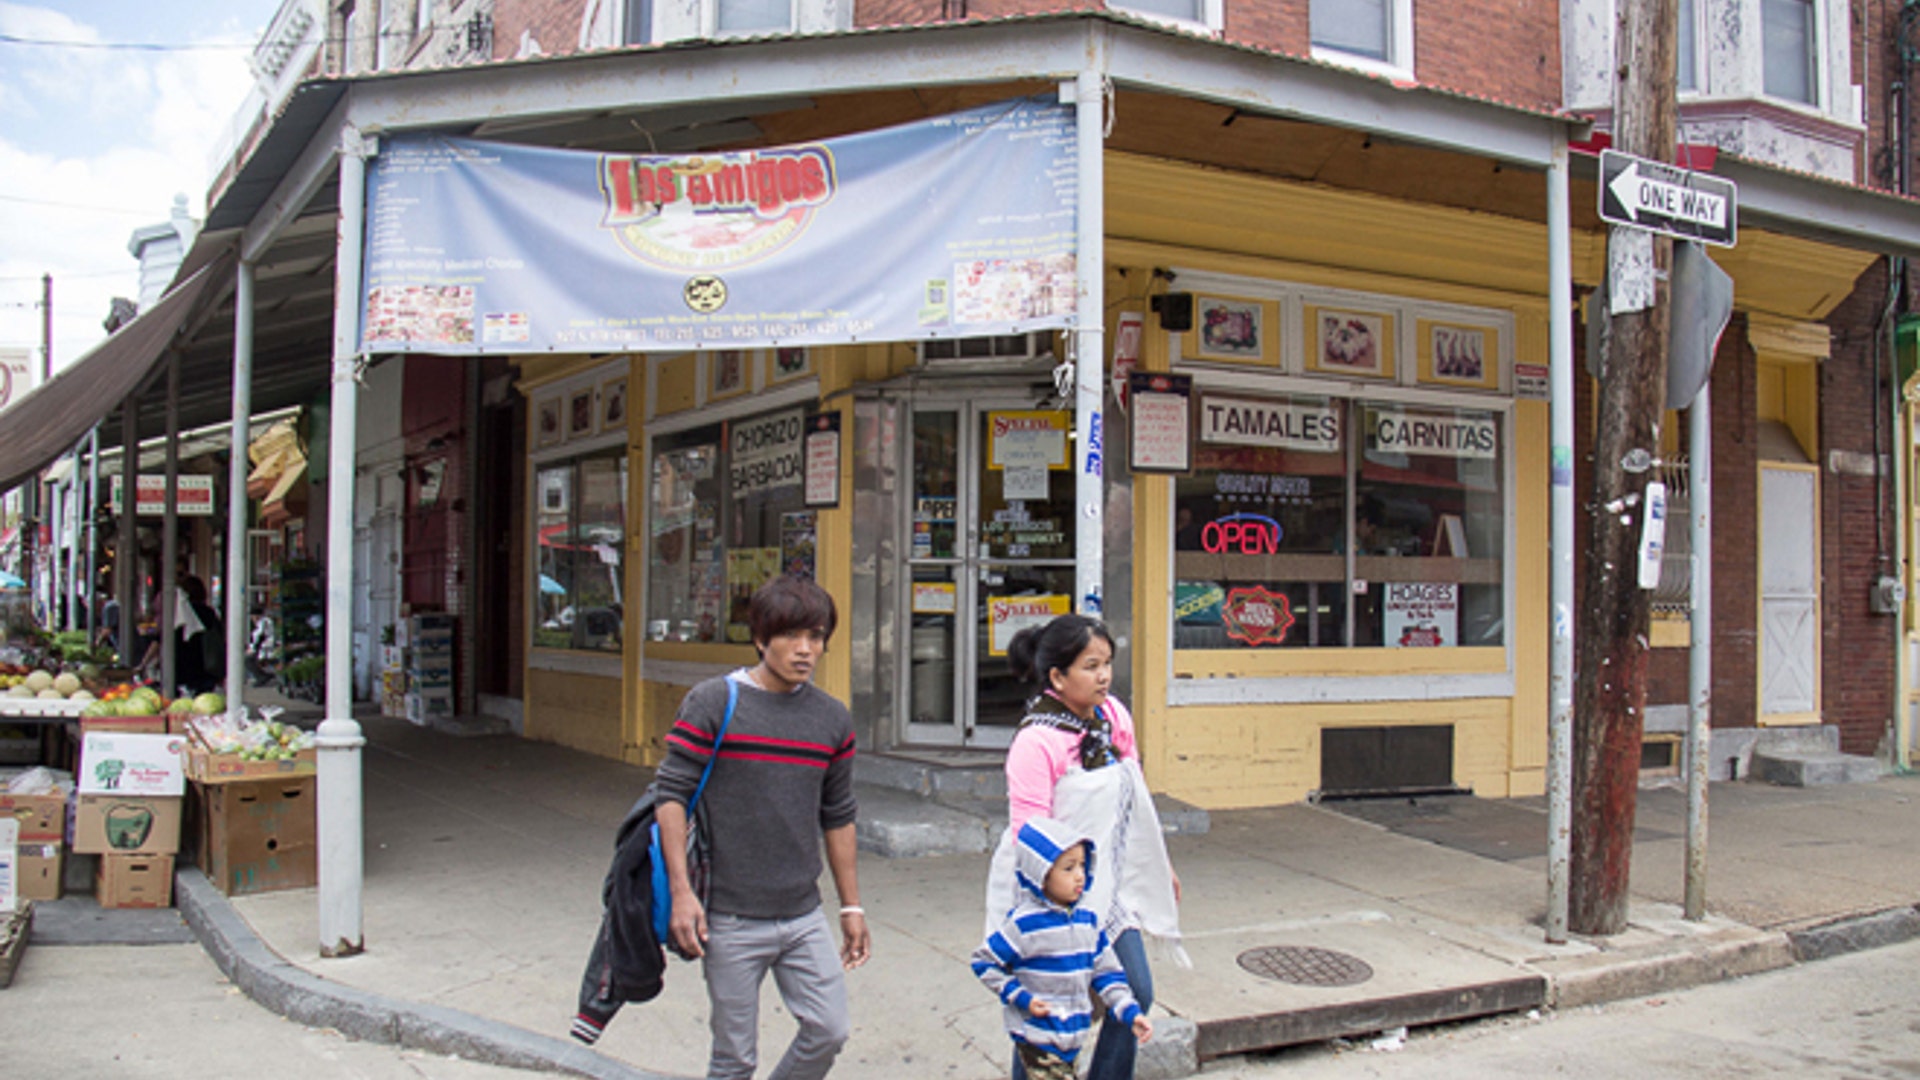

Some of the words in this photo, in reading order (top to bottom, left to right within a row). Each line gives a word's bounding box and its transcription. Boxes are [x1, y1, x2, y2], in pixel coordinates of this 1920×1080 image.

[1639, 180, 1676, 213] ONE
[1680, 190, 1720, 221] WAY
[735, 416, 800, 453] CHORIZO
[1207, 404, 1338, 440] TAMALES
[1378, 417, 1494, 450] CARNITAS
[1201, 521, 1278, 555] OPEN
[1389, 583, 1453, 601] HOAGIES
